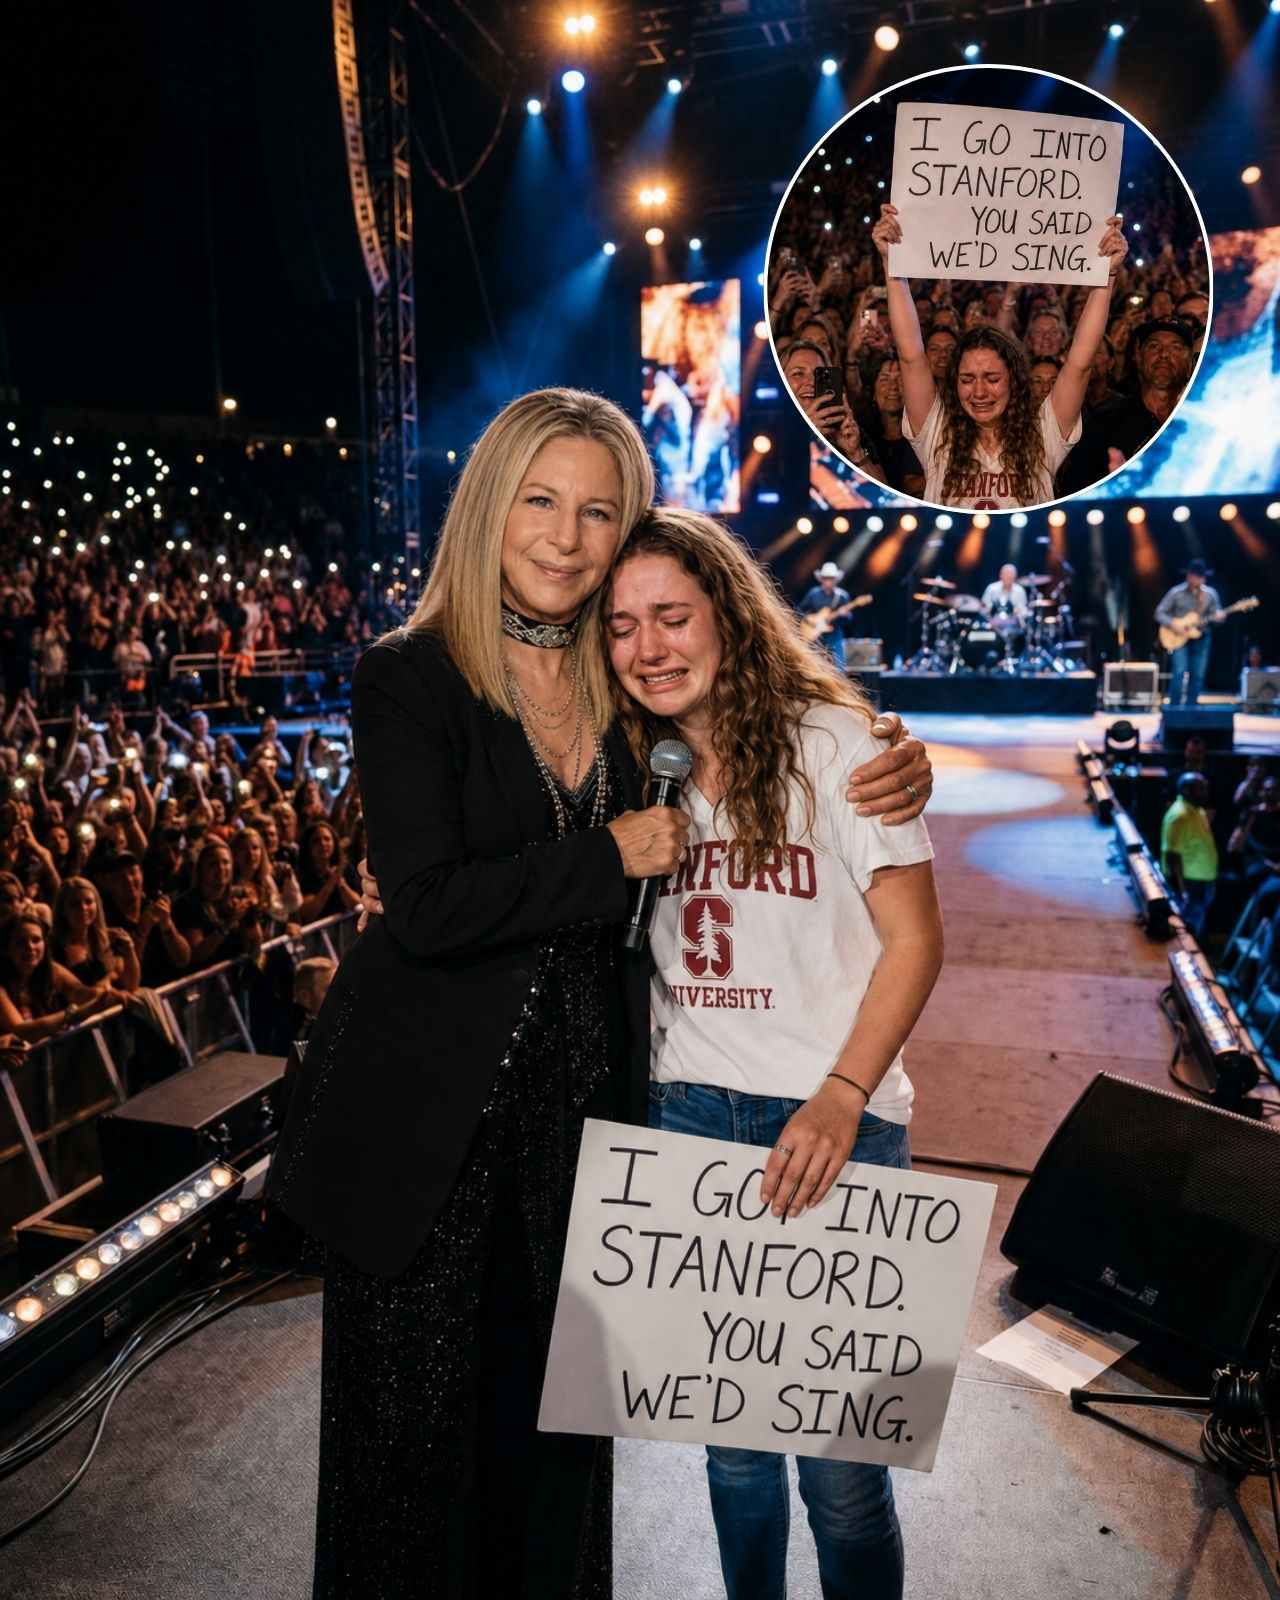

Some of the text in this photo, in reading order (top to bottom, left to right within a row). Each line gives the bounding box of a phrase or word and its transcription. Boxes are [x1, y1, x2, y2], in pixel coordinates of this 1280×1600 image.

[909, 117, 1107, 162] I GO INTO
[908, 161, 1082, 200] STANFORD.
[971, 206, 1092, 235] YOU SAID
[929, 241, 1091, 273] WE'D SING.
[601, 1146, 659, 1208] I
[825, 1183, 961, 1244] INTO
[592, 1224, 906, 1312] STANFORD.
[703, 1311, 923, 1377] YOU SAID
[622, 1370, 914, 1444] WE'D SING.
